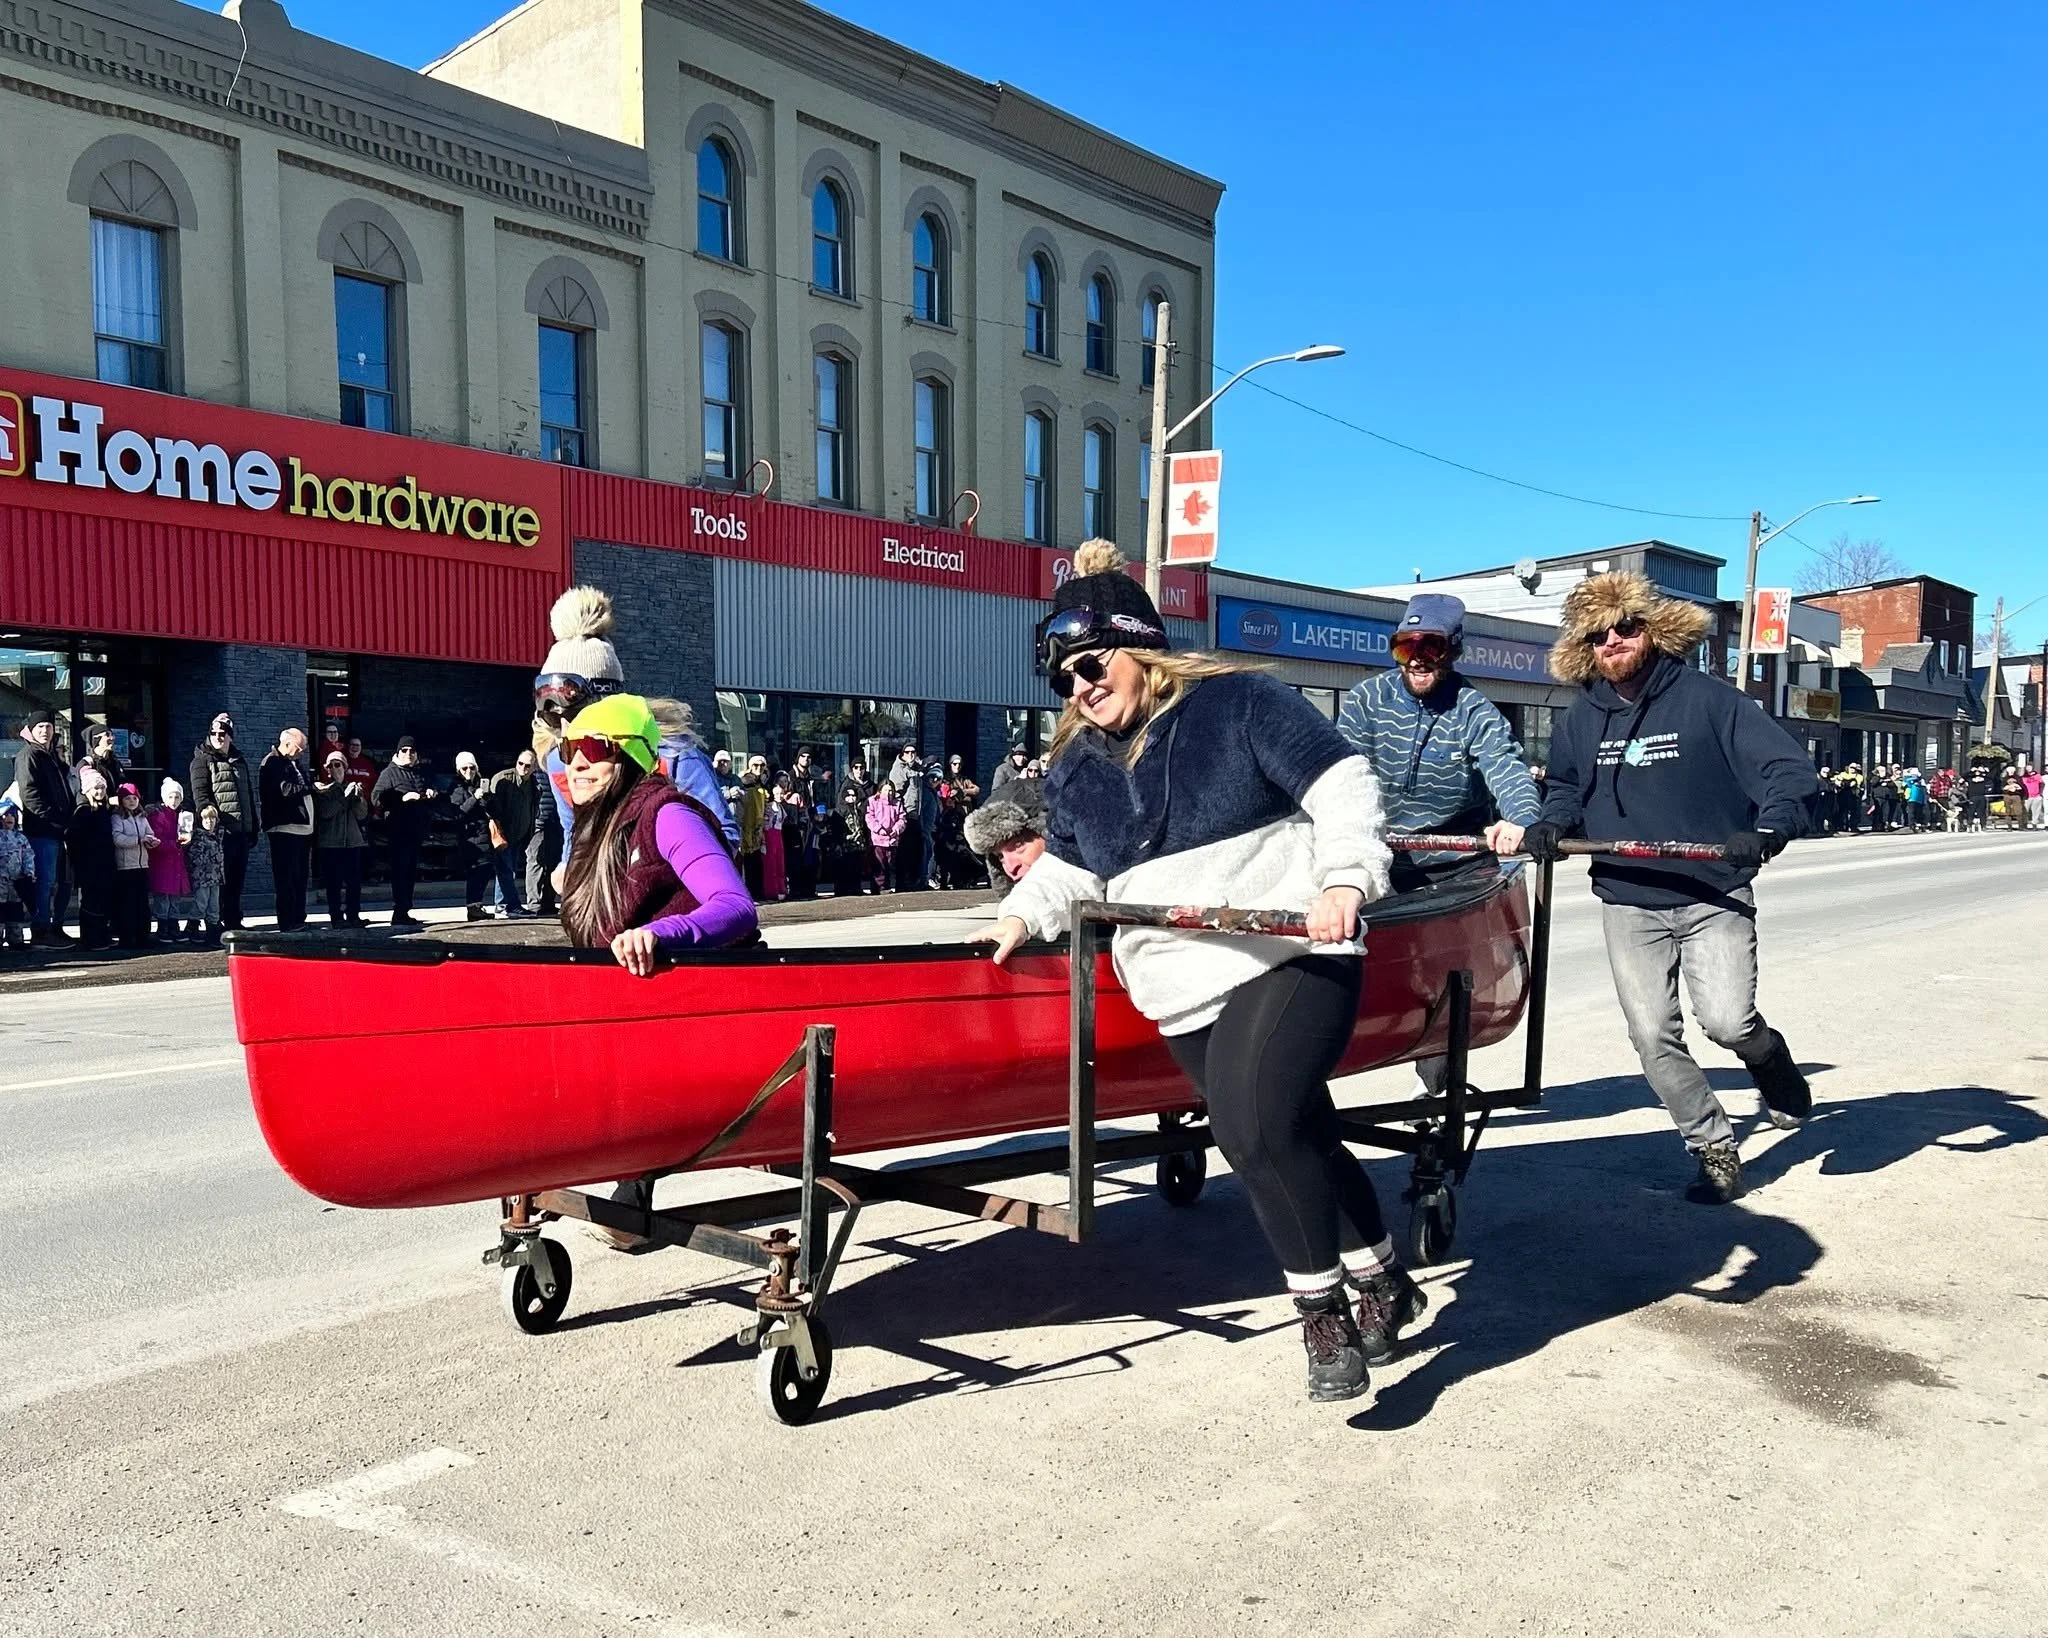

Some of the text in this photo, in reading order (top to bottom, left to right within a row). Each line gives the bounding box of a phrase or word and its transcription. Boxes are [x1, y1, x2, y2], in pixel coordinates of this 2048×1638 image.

[33, 396, 541, 547] Home hardware
[691, 508, 748, 541] Tools
[883, 538, 964, 572] Electrical
[1292, 622, 1389, 653] LAKEFIELD
[1458, 645, 1535, 672] ARMACY
